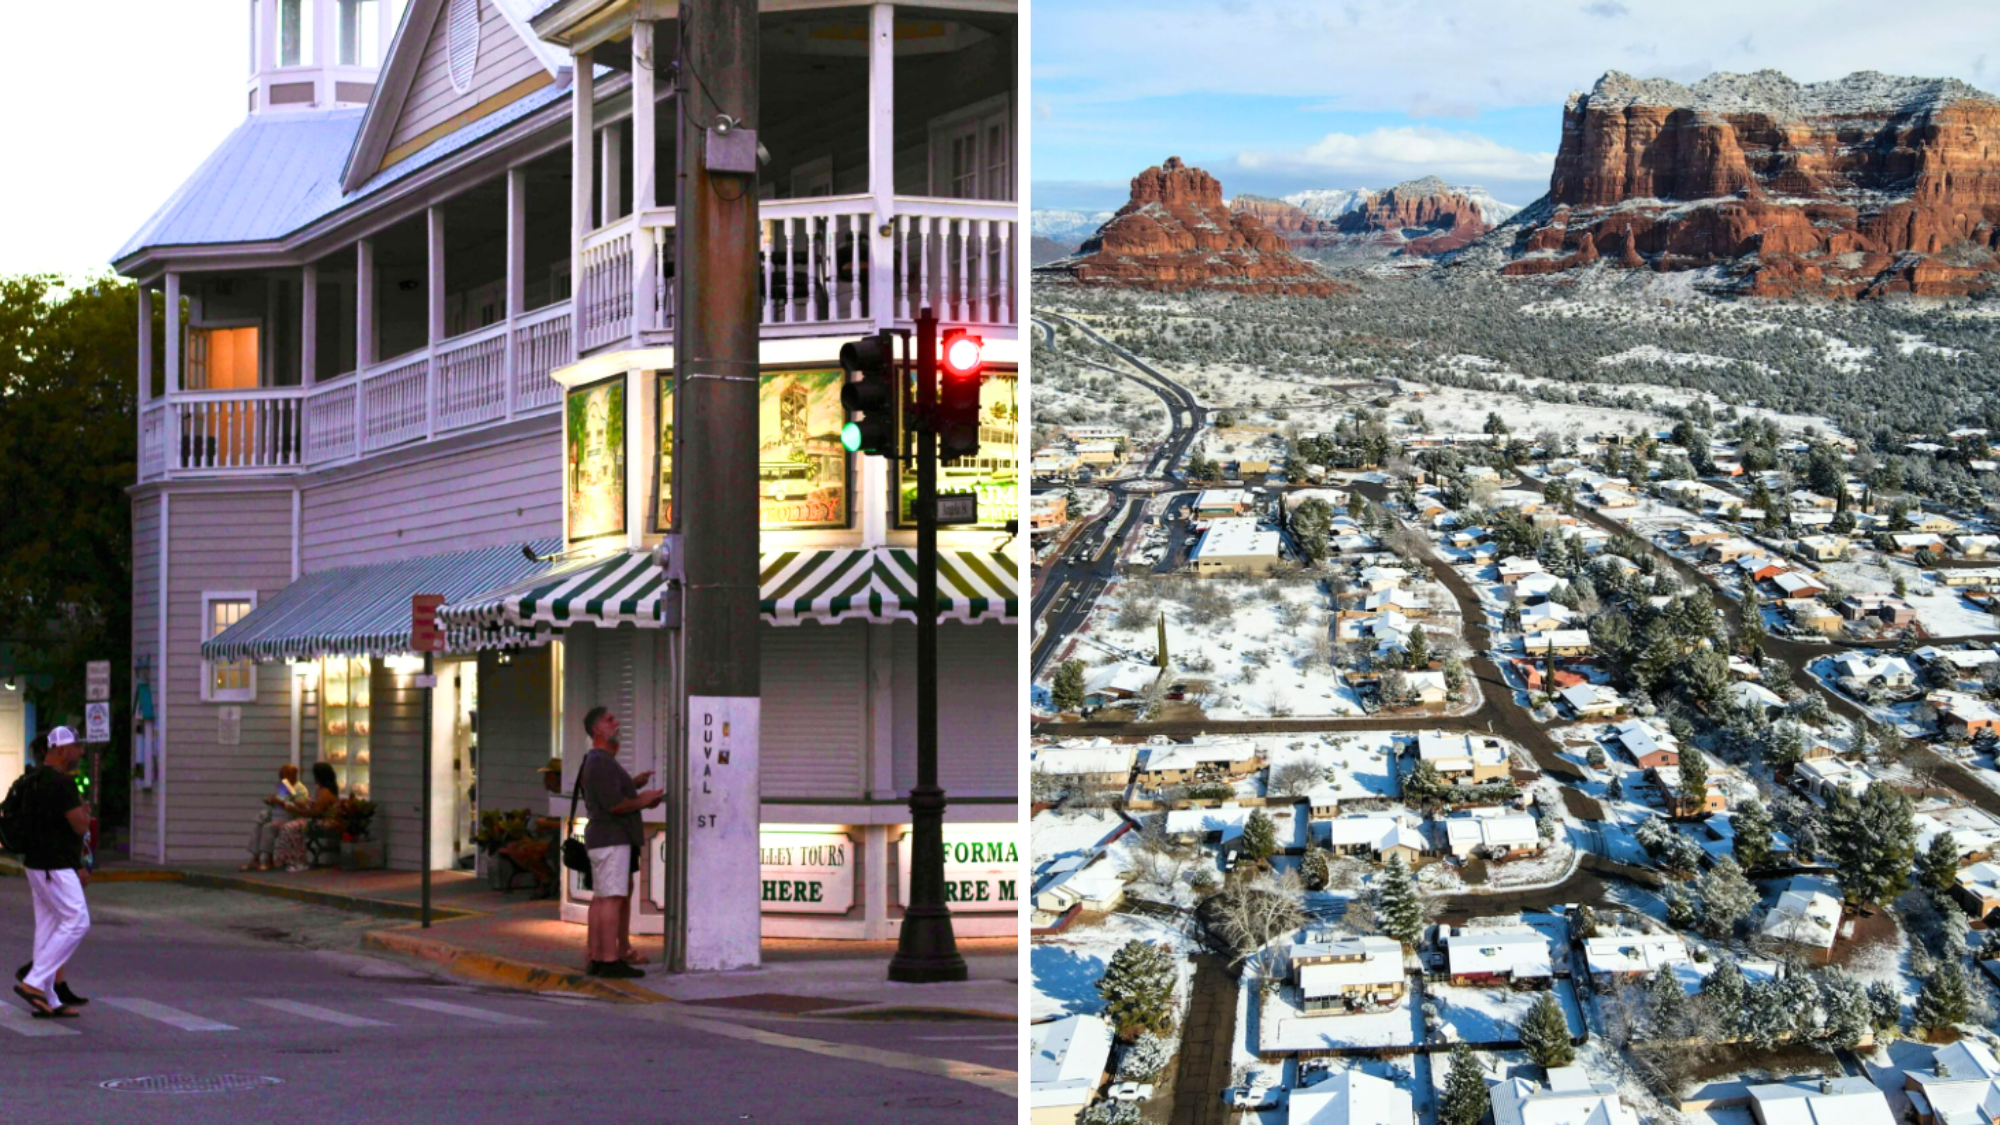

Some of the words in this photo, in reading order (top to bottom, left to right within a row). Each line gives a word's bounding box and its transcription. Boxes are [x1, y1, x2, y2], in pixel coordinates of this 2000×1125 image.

[703, 712, 714, 795] DUVAL
[697, 814, 717, 829] ST
[800, 844, 845, 867] TOURS
[761, 880, 823, 902] HERE
[998, 880, 1018, 902] M
